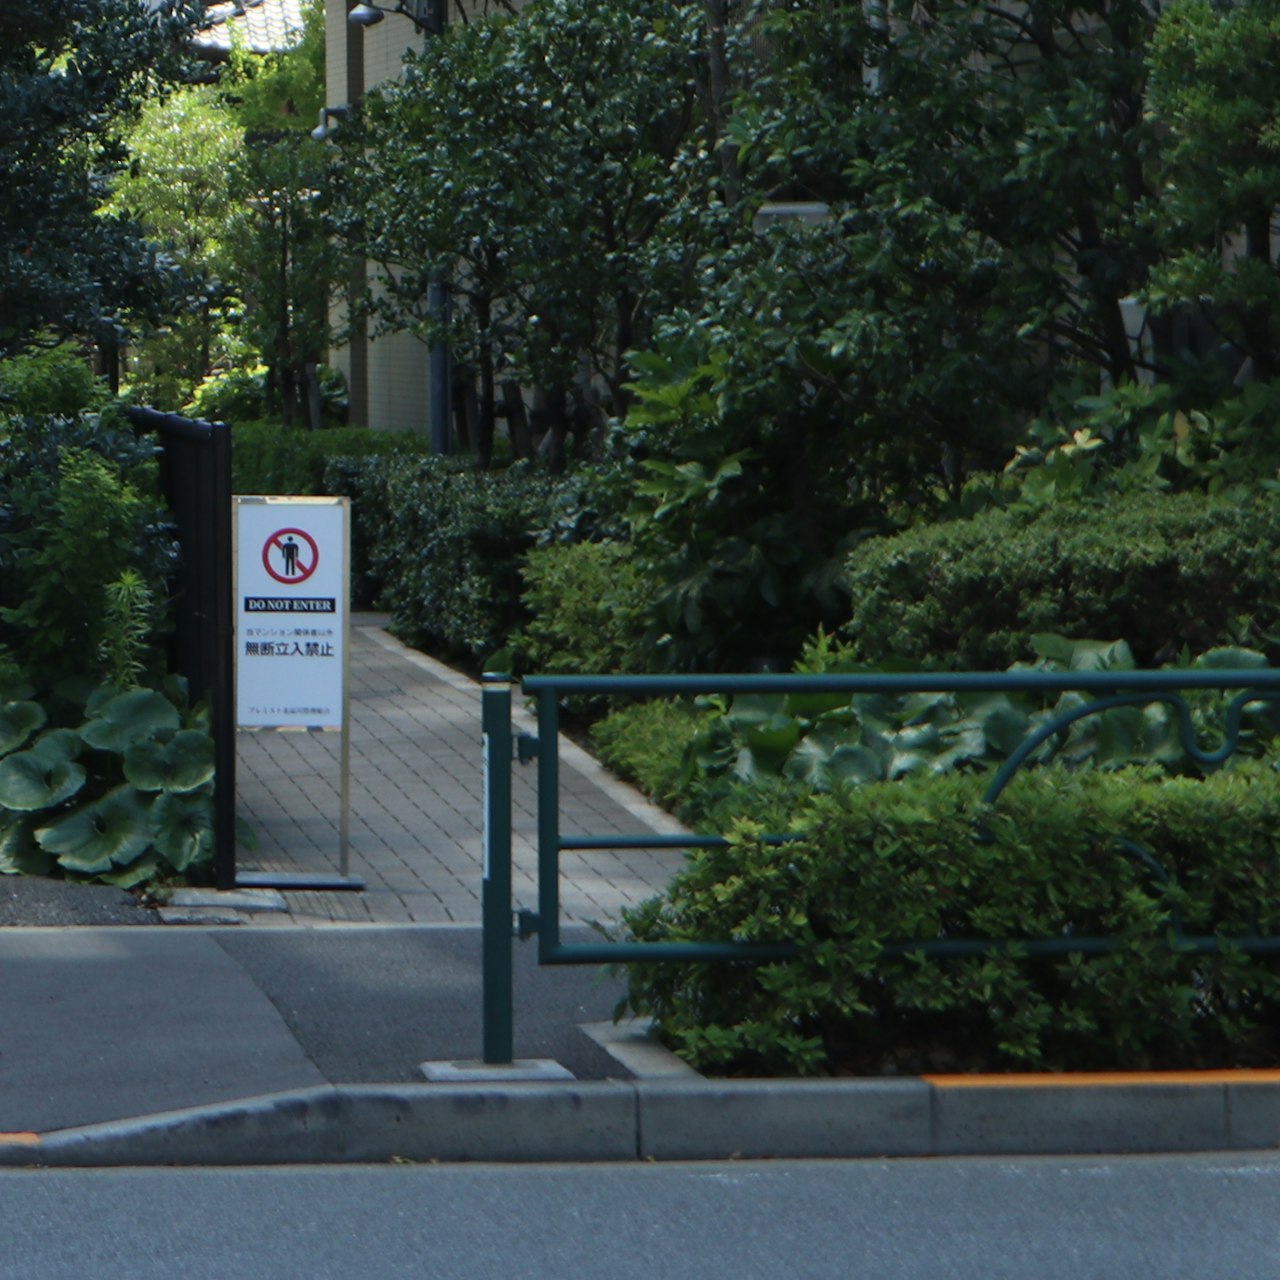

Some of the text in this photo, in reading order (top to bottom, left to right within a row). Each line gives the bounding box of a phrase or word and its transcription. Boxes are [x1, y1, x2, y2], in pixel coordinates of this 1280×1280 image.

[248, 599, 331, 610] DO NOT ENTER
[245, 641, 334, 657] 無断立入禁止
